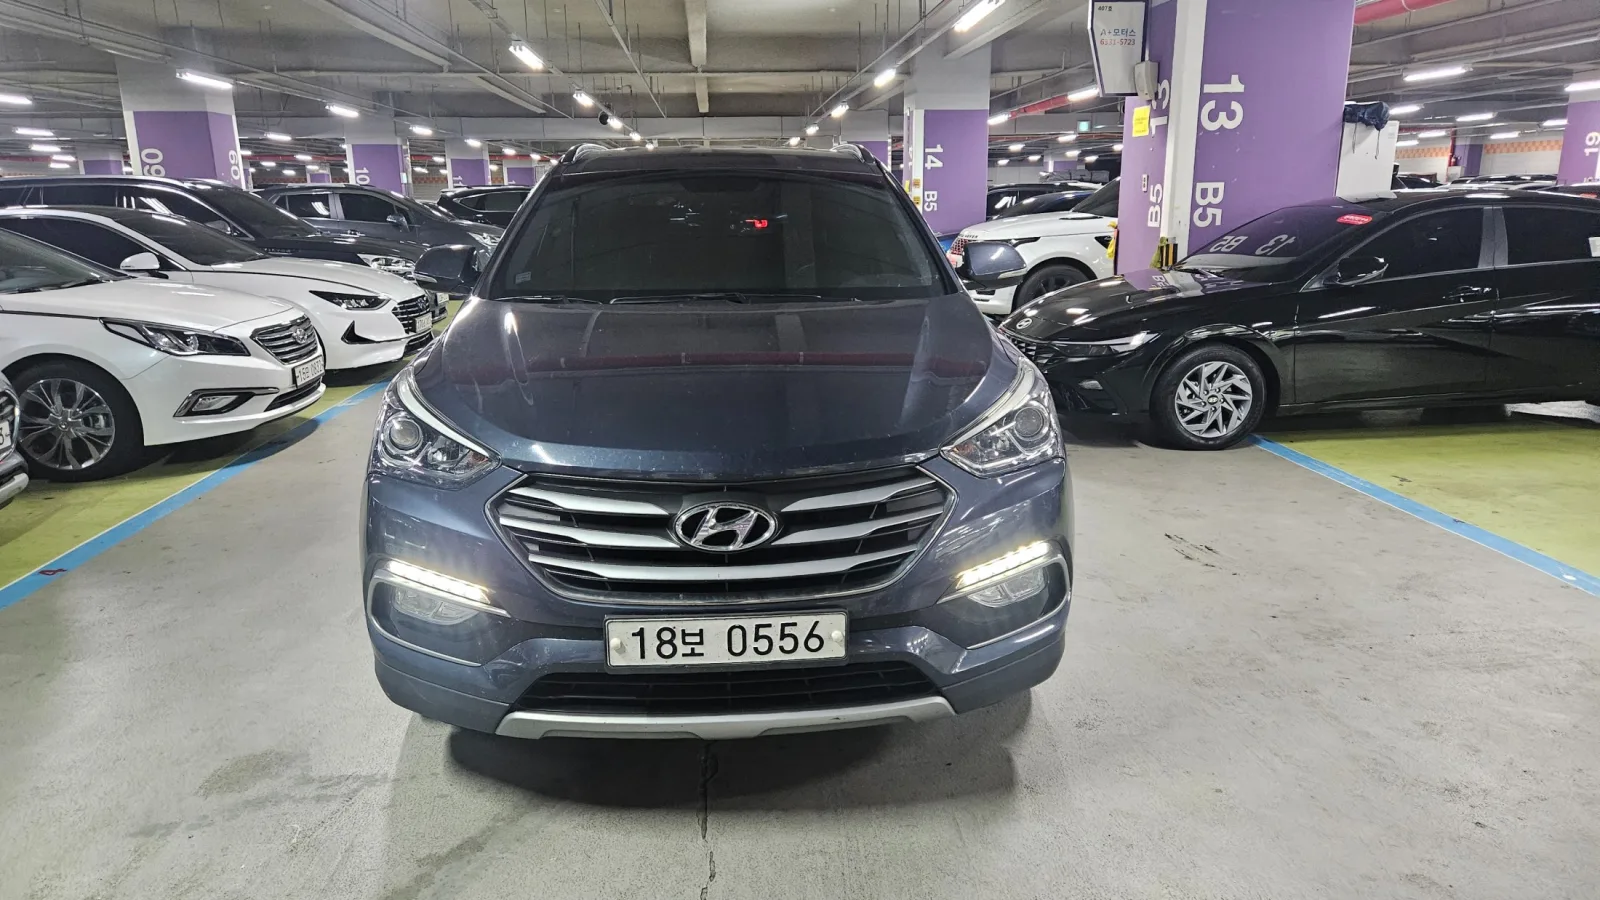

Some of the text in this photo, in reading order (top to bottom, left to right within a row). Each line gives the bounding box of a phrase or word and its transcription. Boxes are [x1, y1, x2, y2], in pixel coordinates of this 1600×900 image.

[141, 148, 166, 177] 09
[1193, 74, 1245, 228] 13 B5
[355, 167, 370, 185] 10
[923, 144, 943, 212] 14 B5
[1147, 183, 1163, 228] B5
[631, 620, 825, 660] 18보 0556
